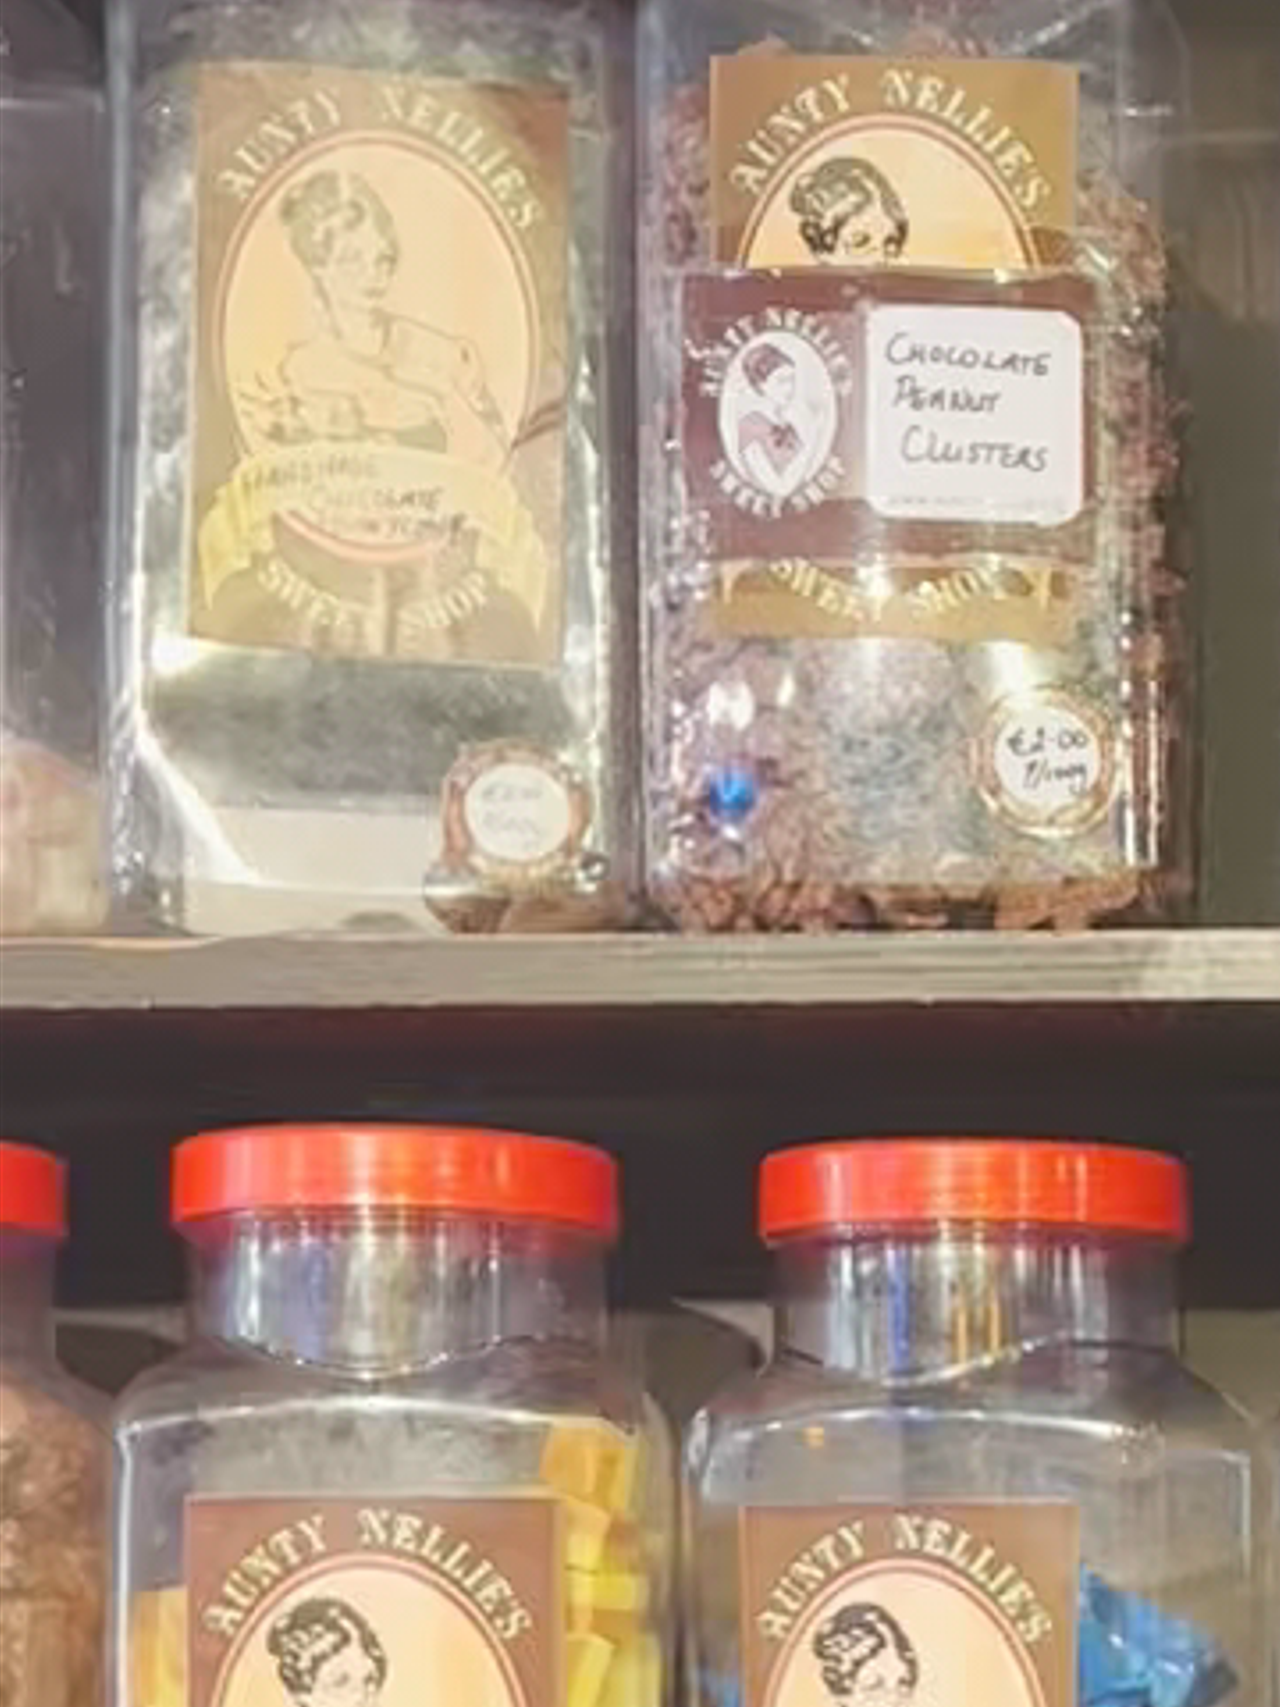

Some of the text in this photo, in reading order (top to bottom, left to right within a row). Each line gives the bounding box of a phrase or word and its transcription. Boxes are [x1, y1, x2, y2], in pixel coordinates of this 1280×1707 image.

[731, 73, 852, 197] AUNTY
[884, 333, 1052, 377] CHOCOLATE
[891, 375, 1000, 412] PEANUT
[901, 425, 1049, 472] CLUSTERS
[202, 1516, 327, 1638] AUNTY
[758, 1519, 867, 1641] AUNTY
